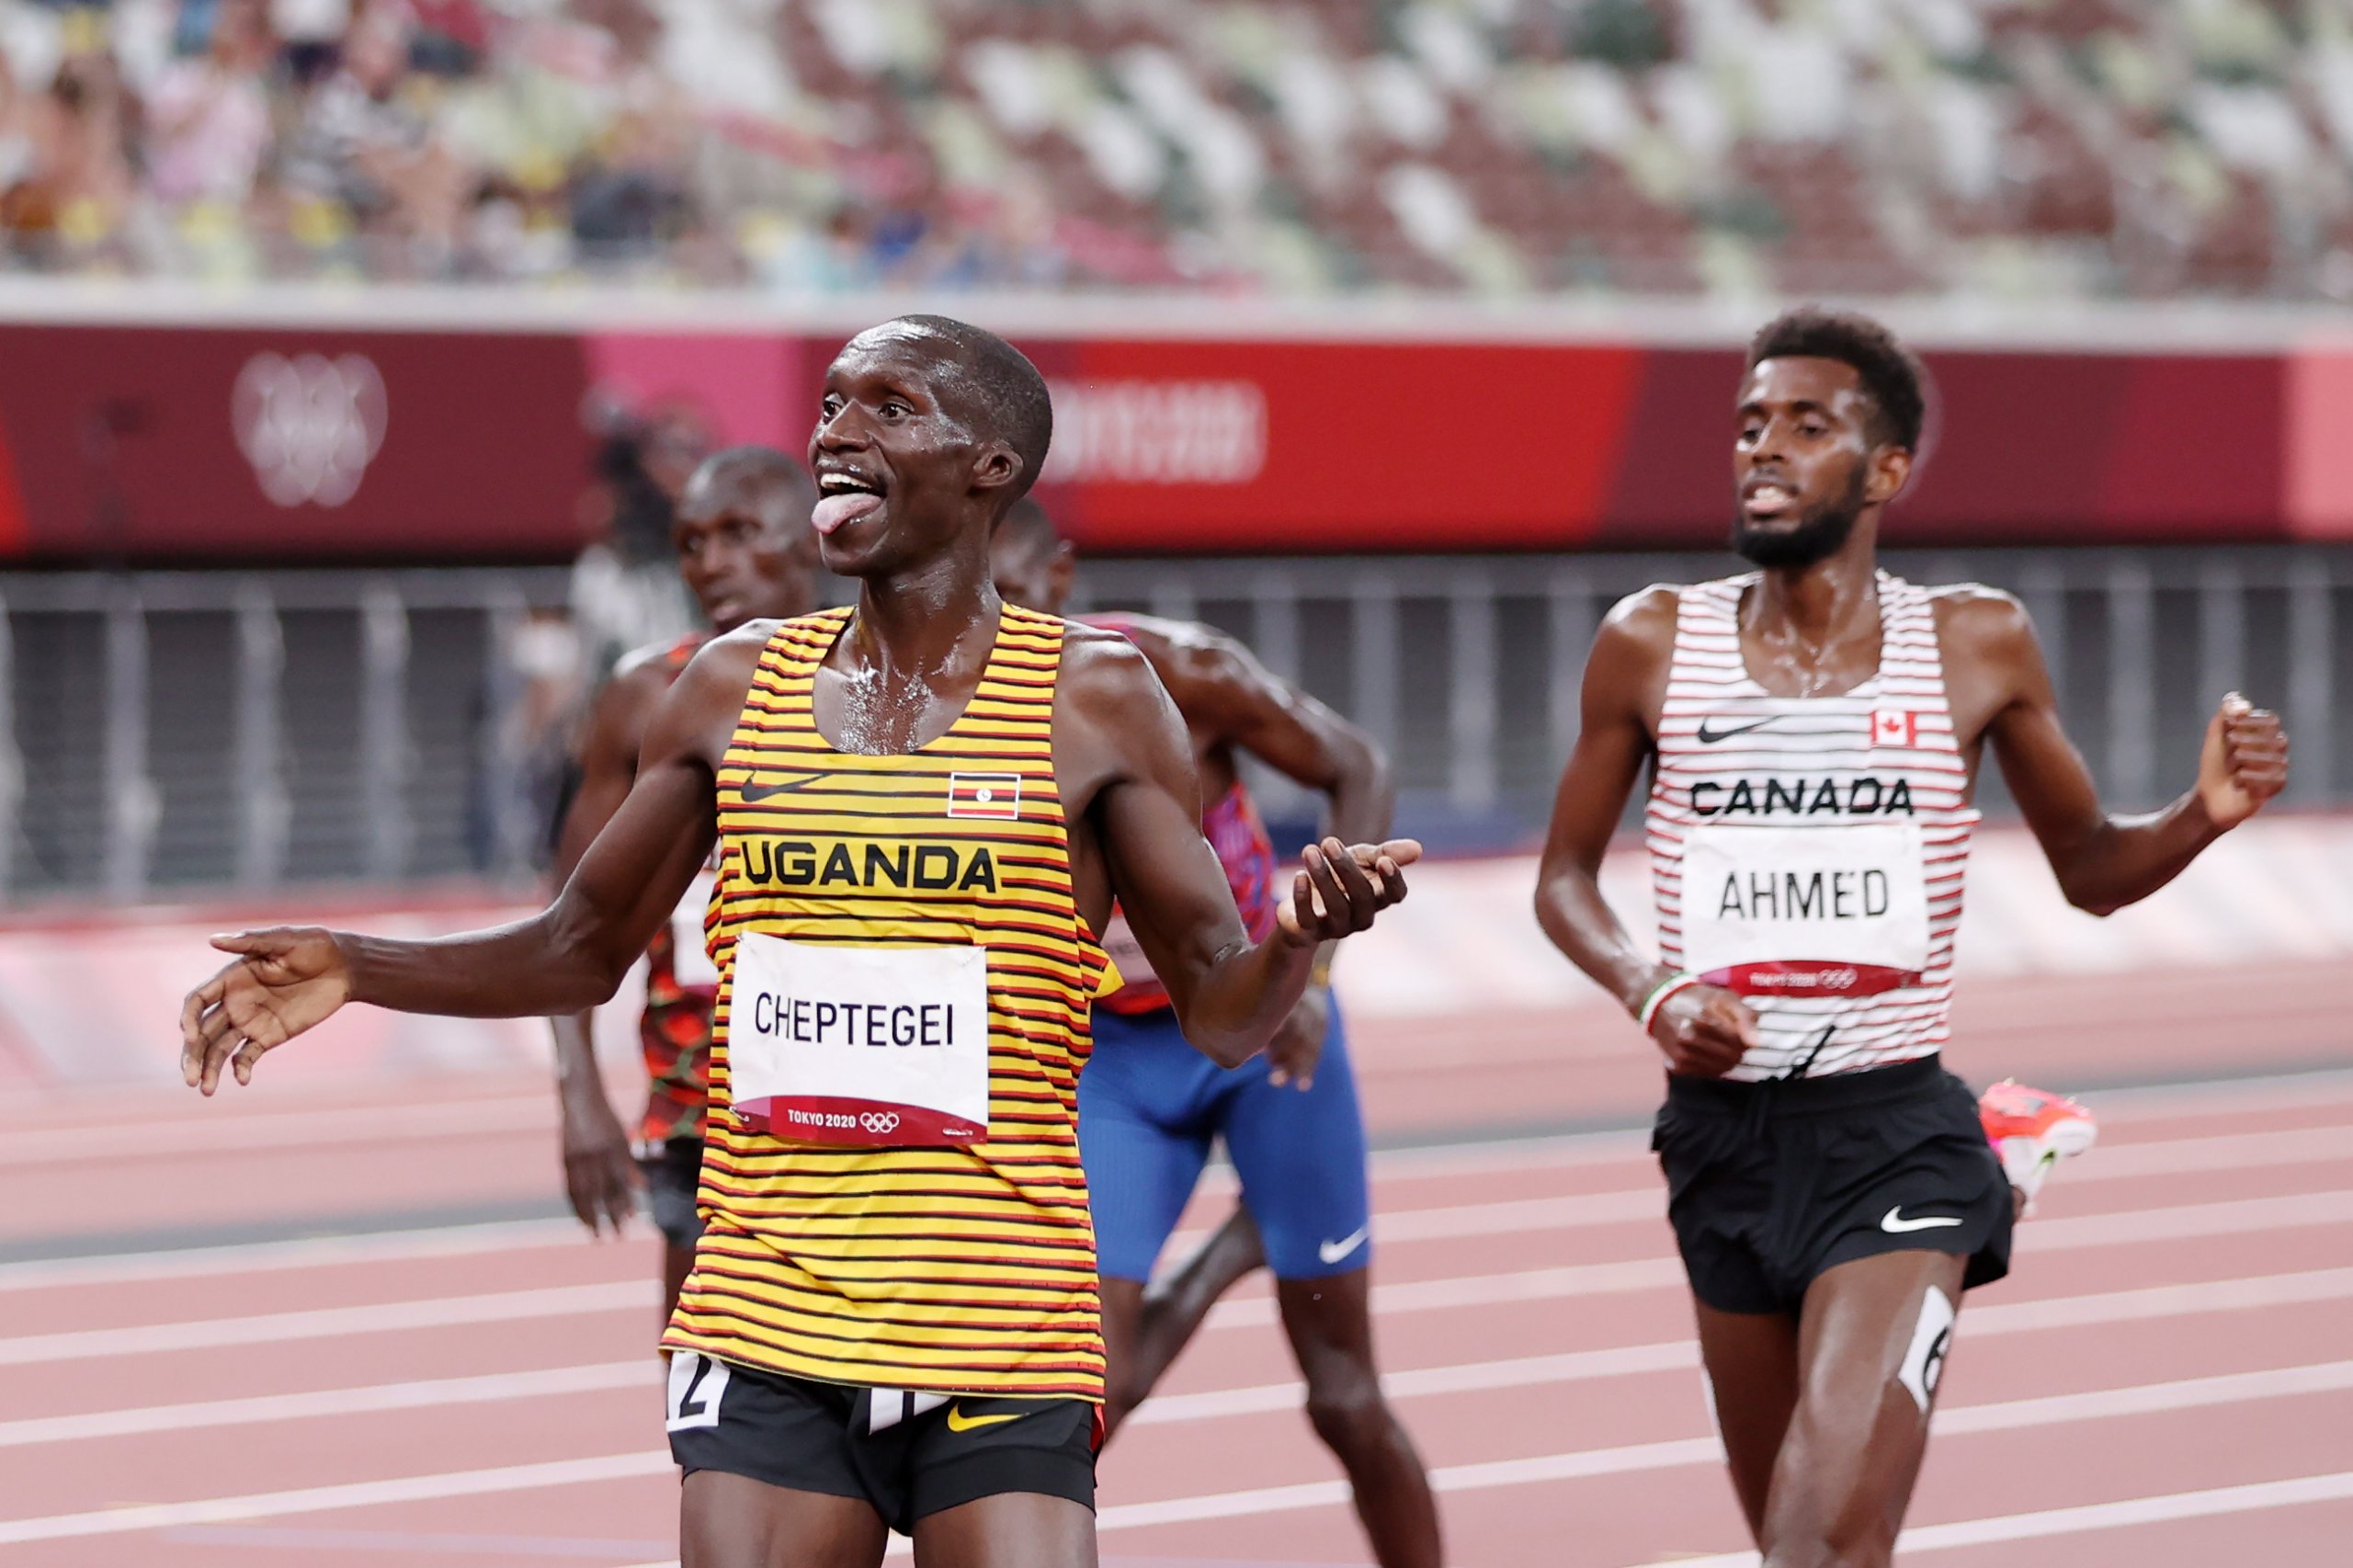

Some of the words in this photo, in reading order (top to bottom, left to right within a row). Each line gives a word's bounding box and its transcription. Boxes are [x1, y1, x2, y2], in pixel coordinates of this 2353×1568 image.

[1690, 778, 1914, 815] CANADA
[743, 841, 996, 893] UGANDA
[1719, 869, 1890, 919] AHMED
[755, 992, 953, 1047] CHEPTEGEI
[788, 1109, 824, 1127] TOKYO
[825, 1110, 856, 1129] 2020
